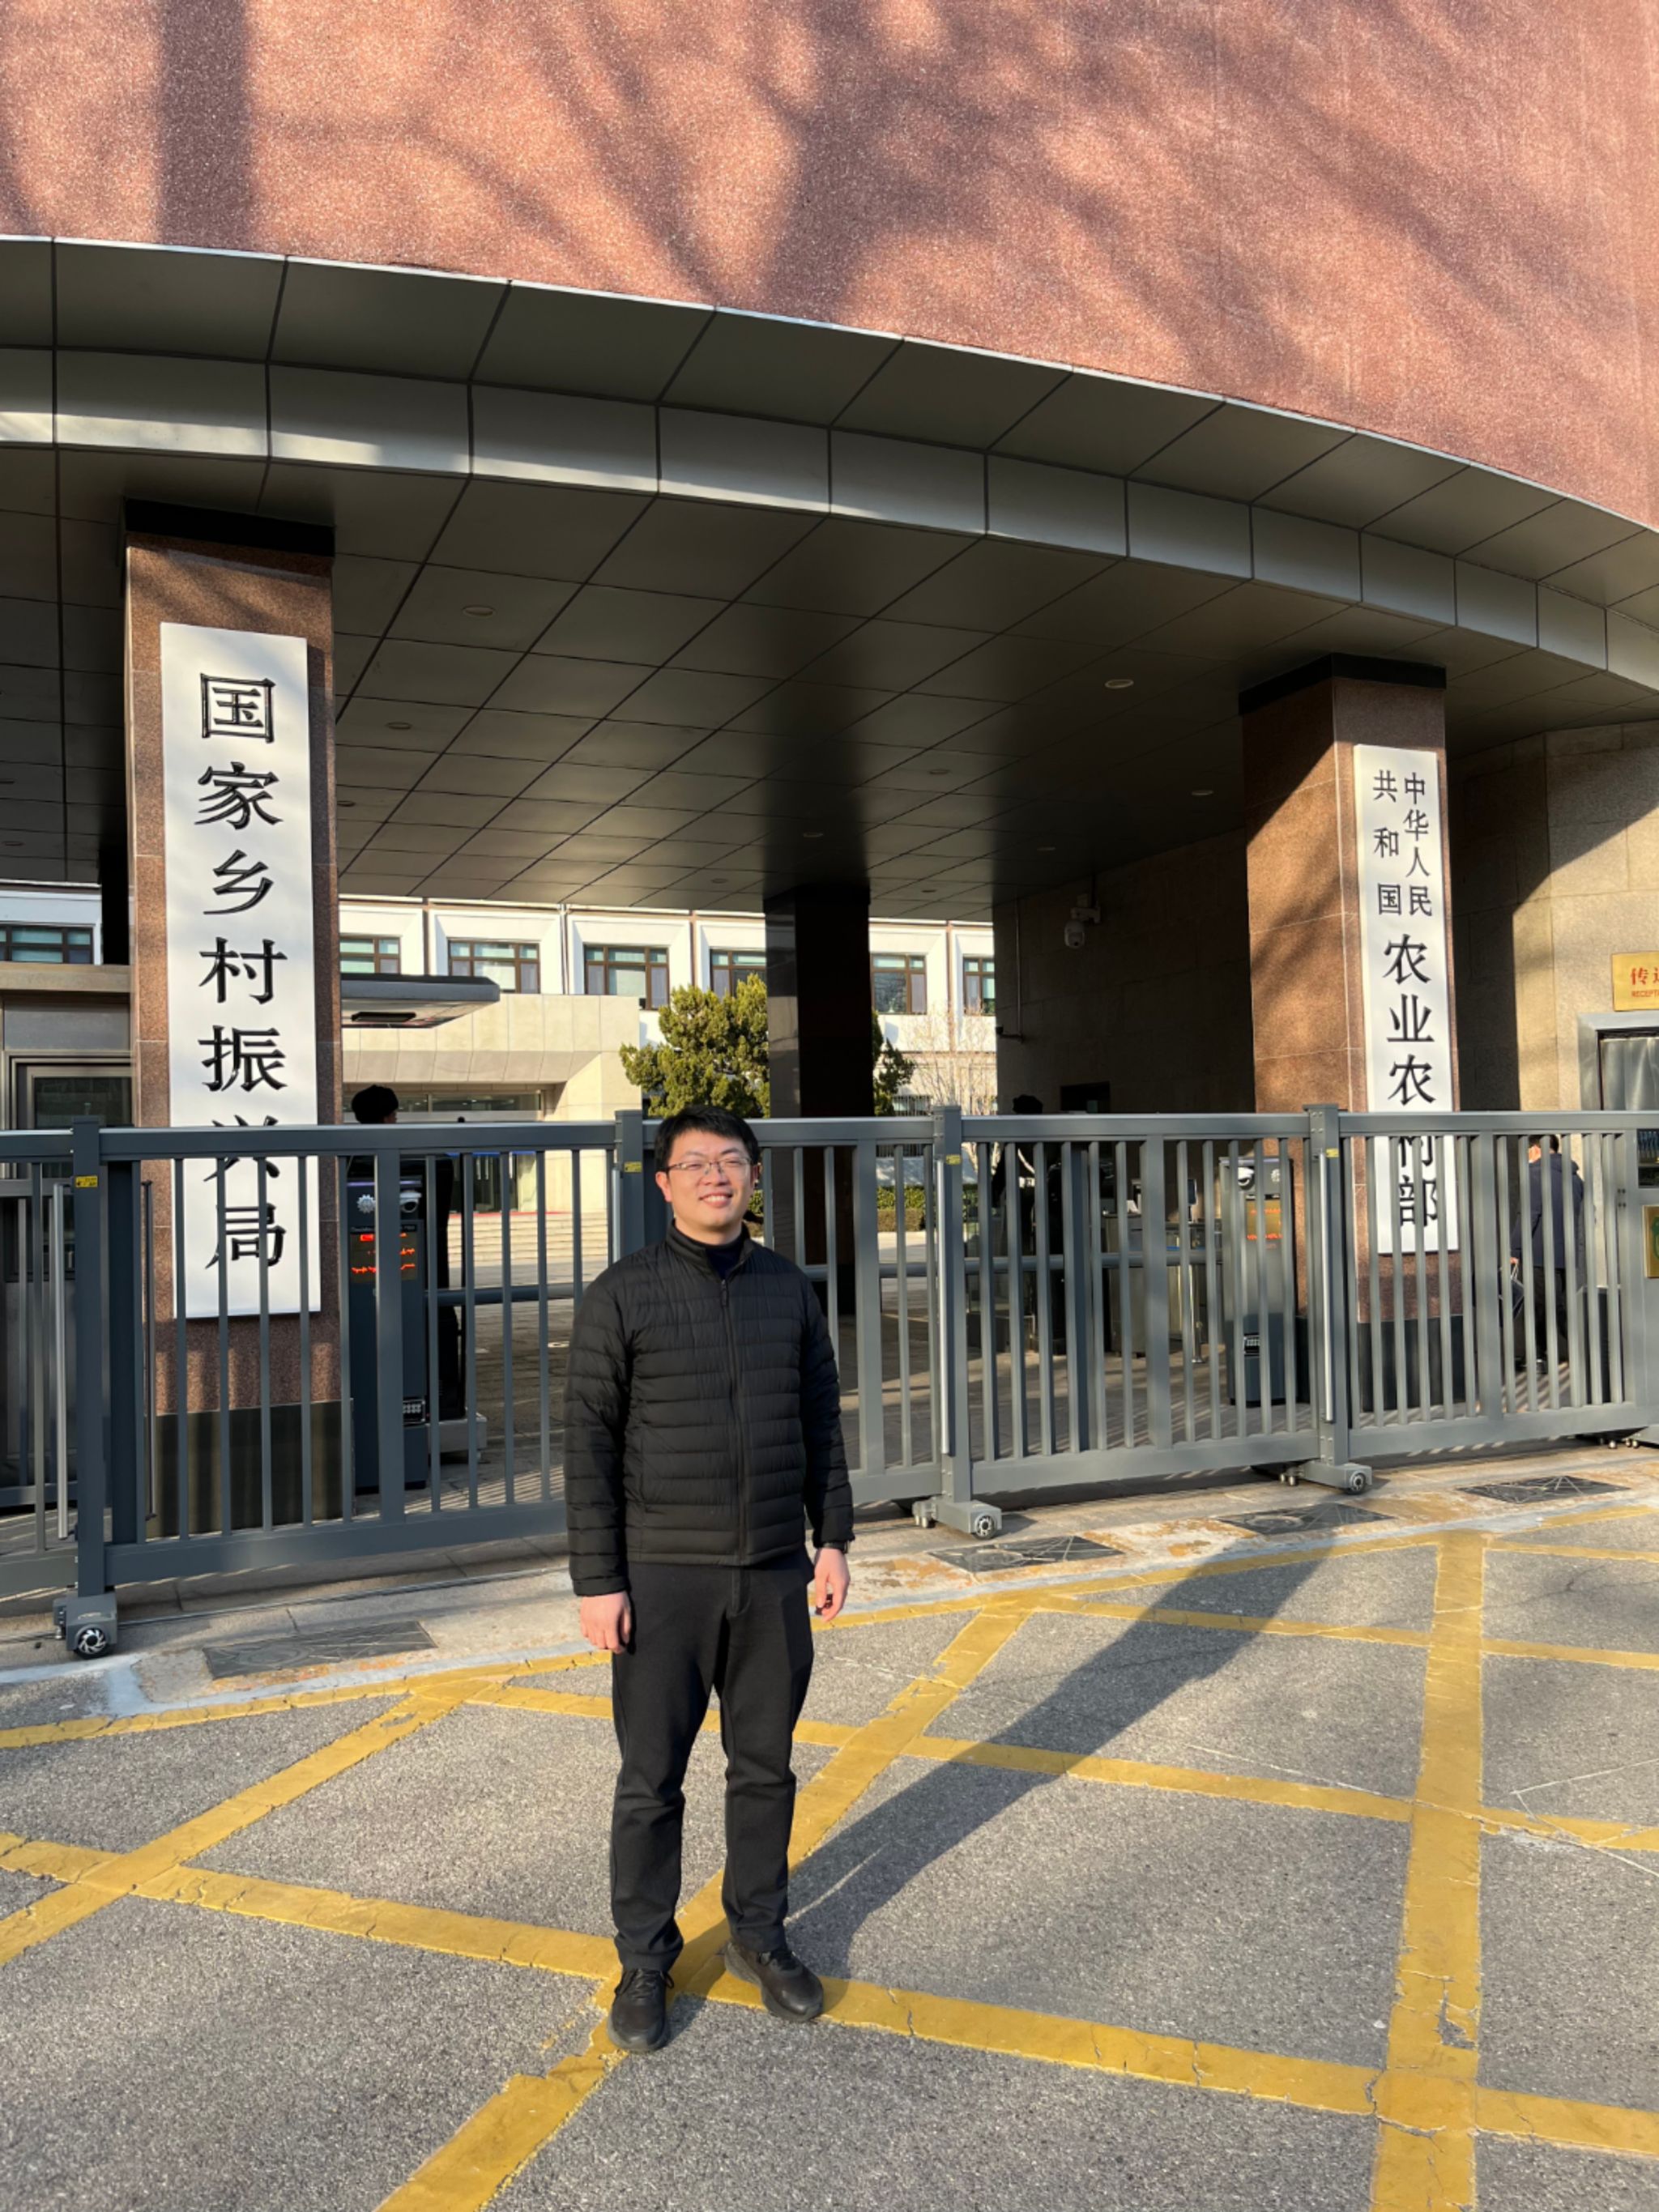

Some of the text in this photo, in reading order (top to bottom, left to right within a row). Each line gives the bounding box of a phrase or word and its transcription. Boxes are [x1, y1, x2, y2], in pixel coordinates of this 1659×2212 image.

[1372, 769, 1401, 915] 共和国
[1403, 772, 1433, 916] 中华人民
